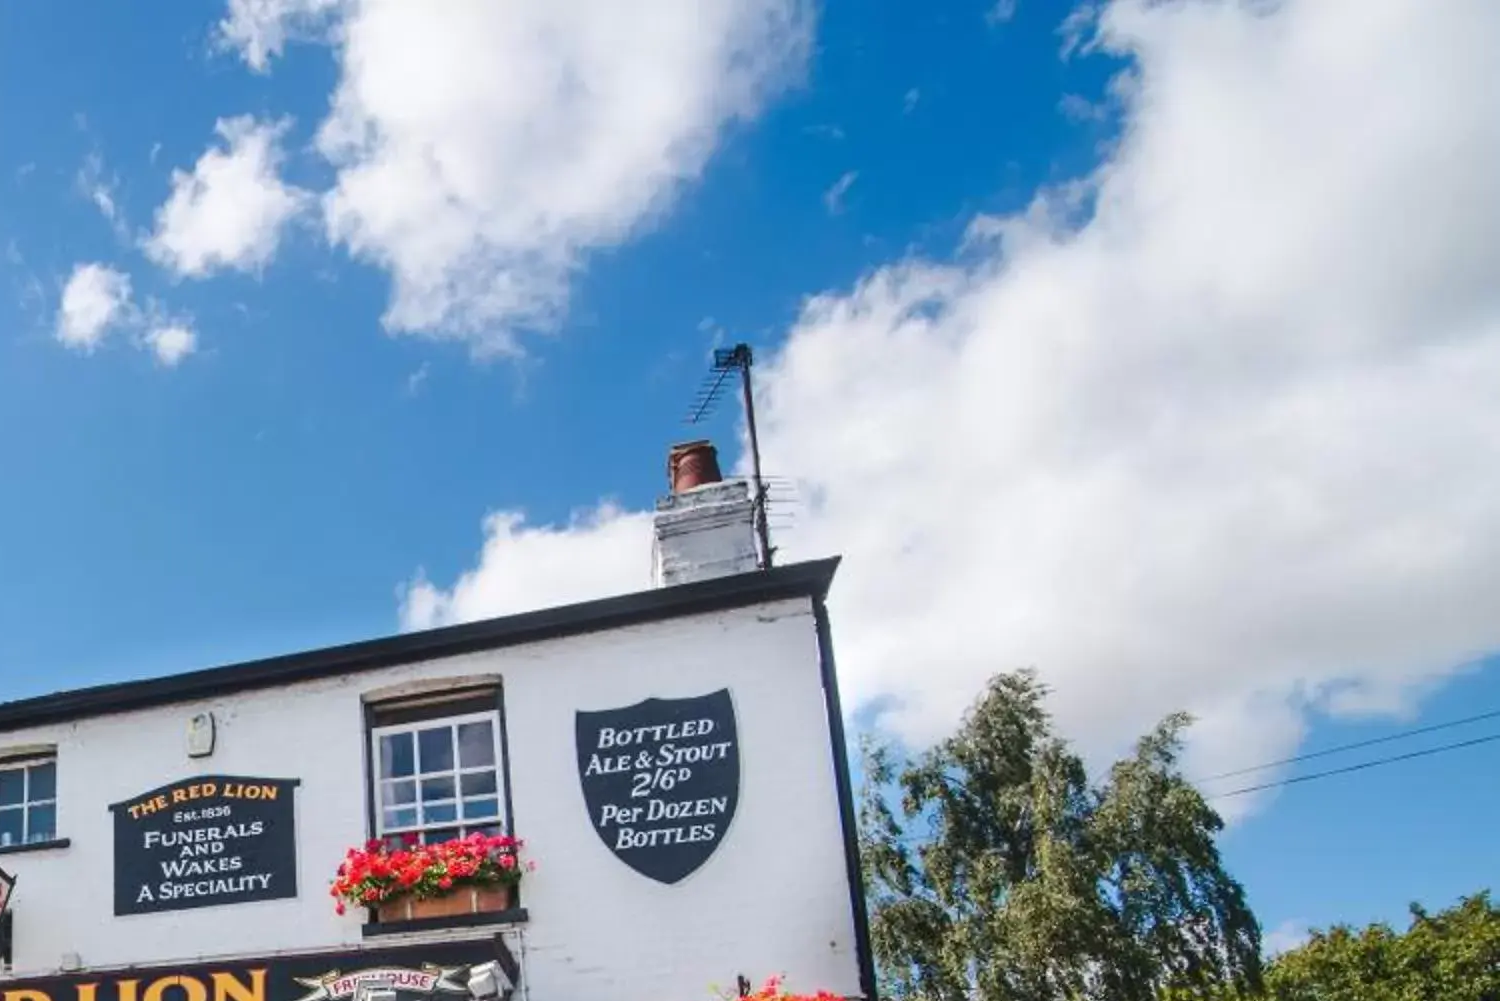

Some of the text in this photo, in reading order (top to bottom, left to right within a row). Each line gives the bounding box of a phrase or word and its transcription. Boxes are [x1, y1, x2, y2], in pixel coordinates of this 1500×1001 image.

[597, 719, 714, 748] BOTTLED
[585, 742, 732, 776] ALE & STOUT
[128, 783, 278, 819] THE RED LION
[600, 797, 728, 827] Per DOZEN
[144, 821, 264, 849] FUNERALS
[179, 841, 225, 858] AND
[616, 824, 716, 850] BOTTLES
[160, 856, 242, 878] WAKES
[136, 873, 272, 902] A SPECIALITY
